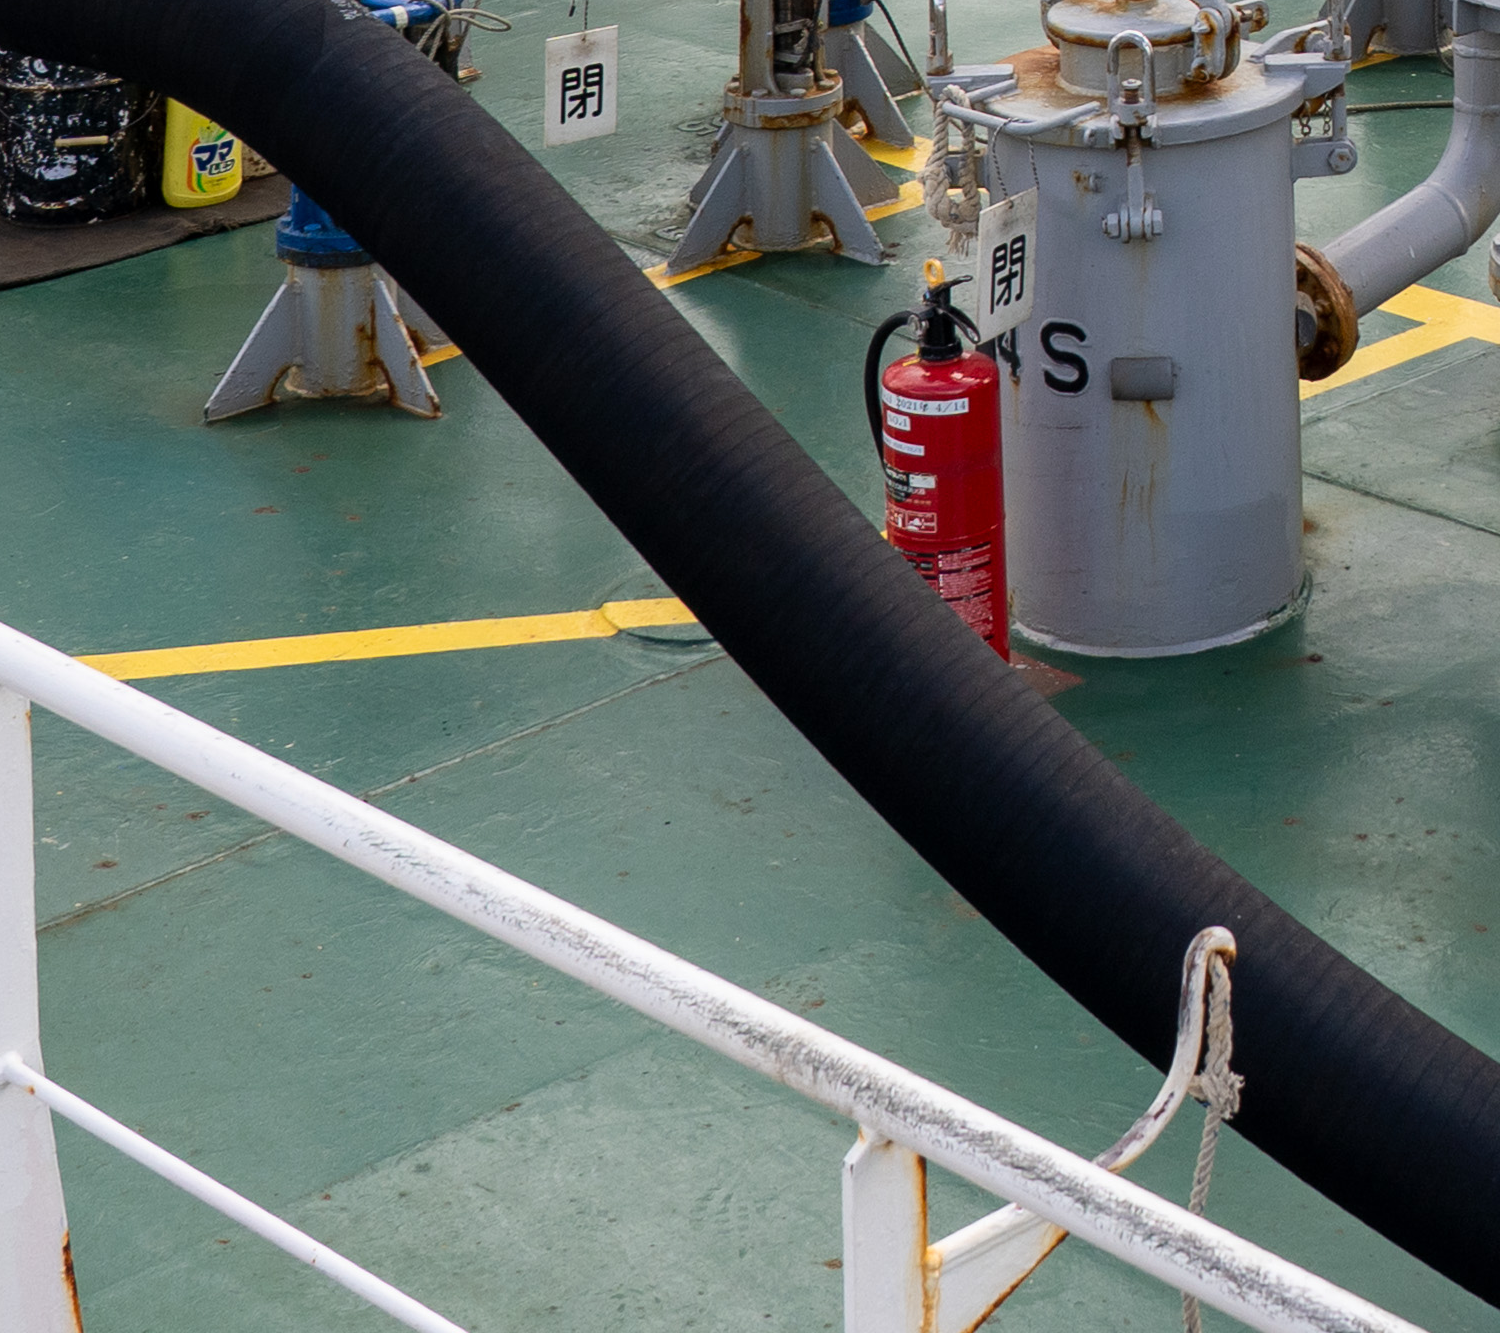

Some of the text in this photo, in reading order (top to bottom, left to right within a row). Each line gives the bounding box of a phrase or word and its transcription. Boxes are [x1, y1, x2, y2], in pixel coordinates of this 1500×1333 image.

[561, 63, 604, 124] 閉
[192, 139, 234, 171] ママ
[990, 234, 1026, 315] 閉
